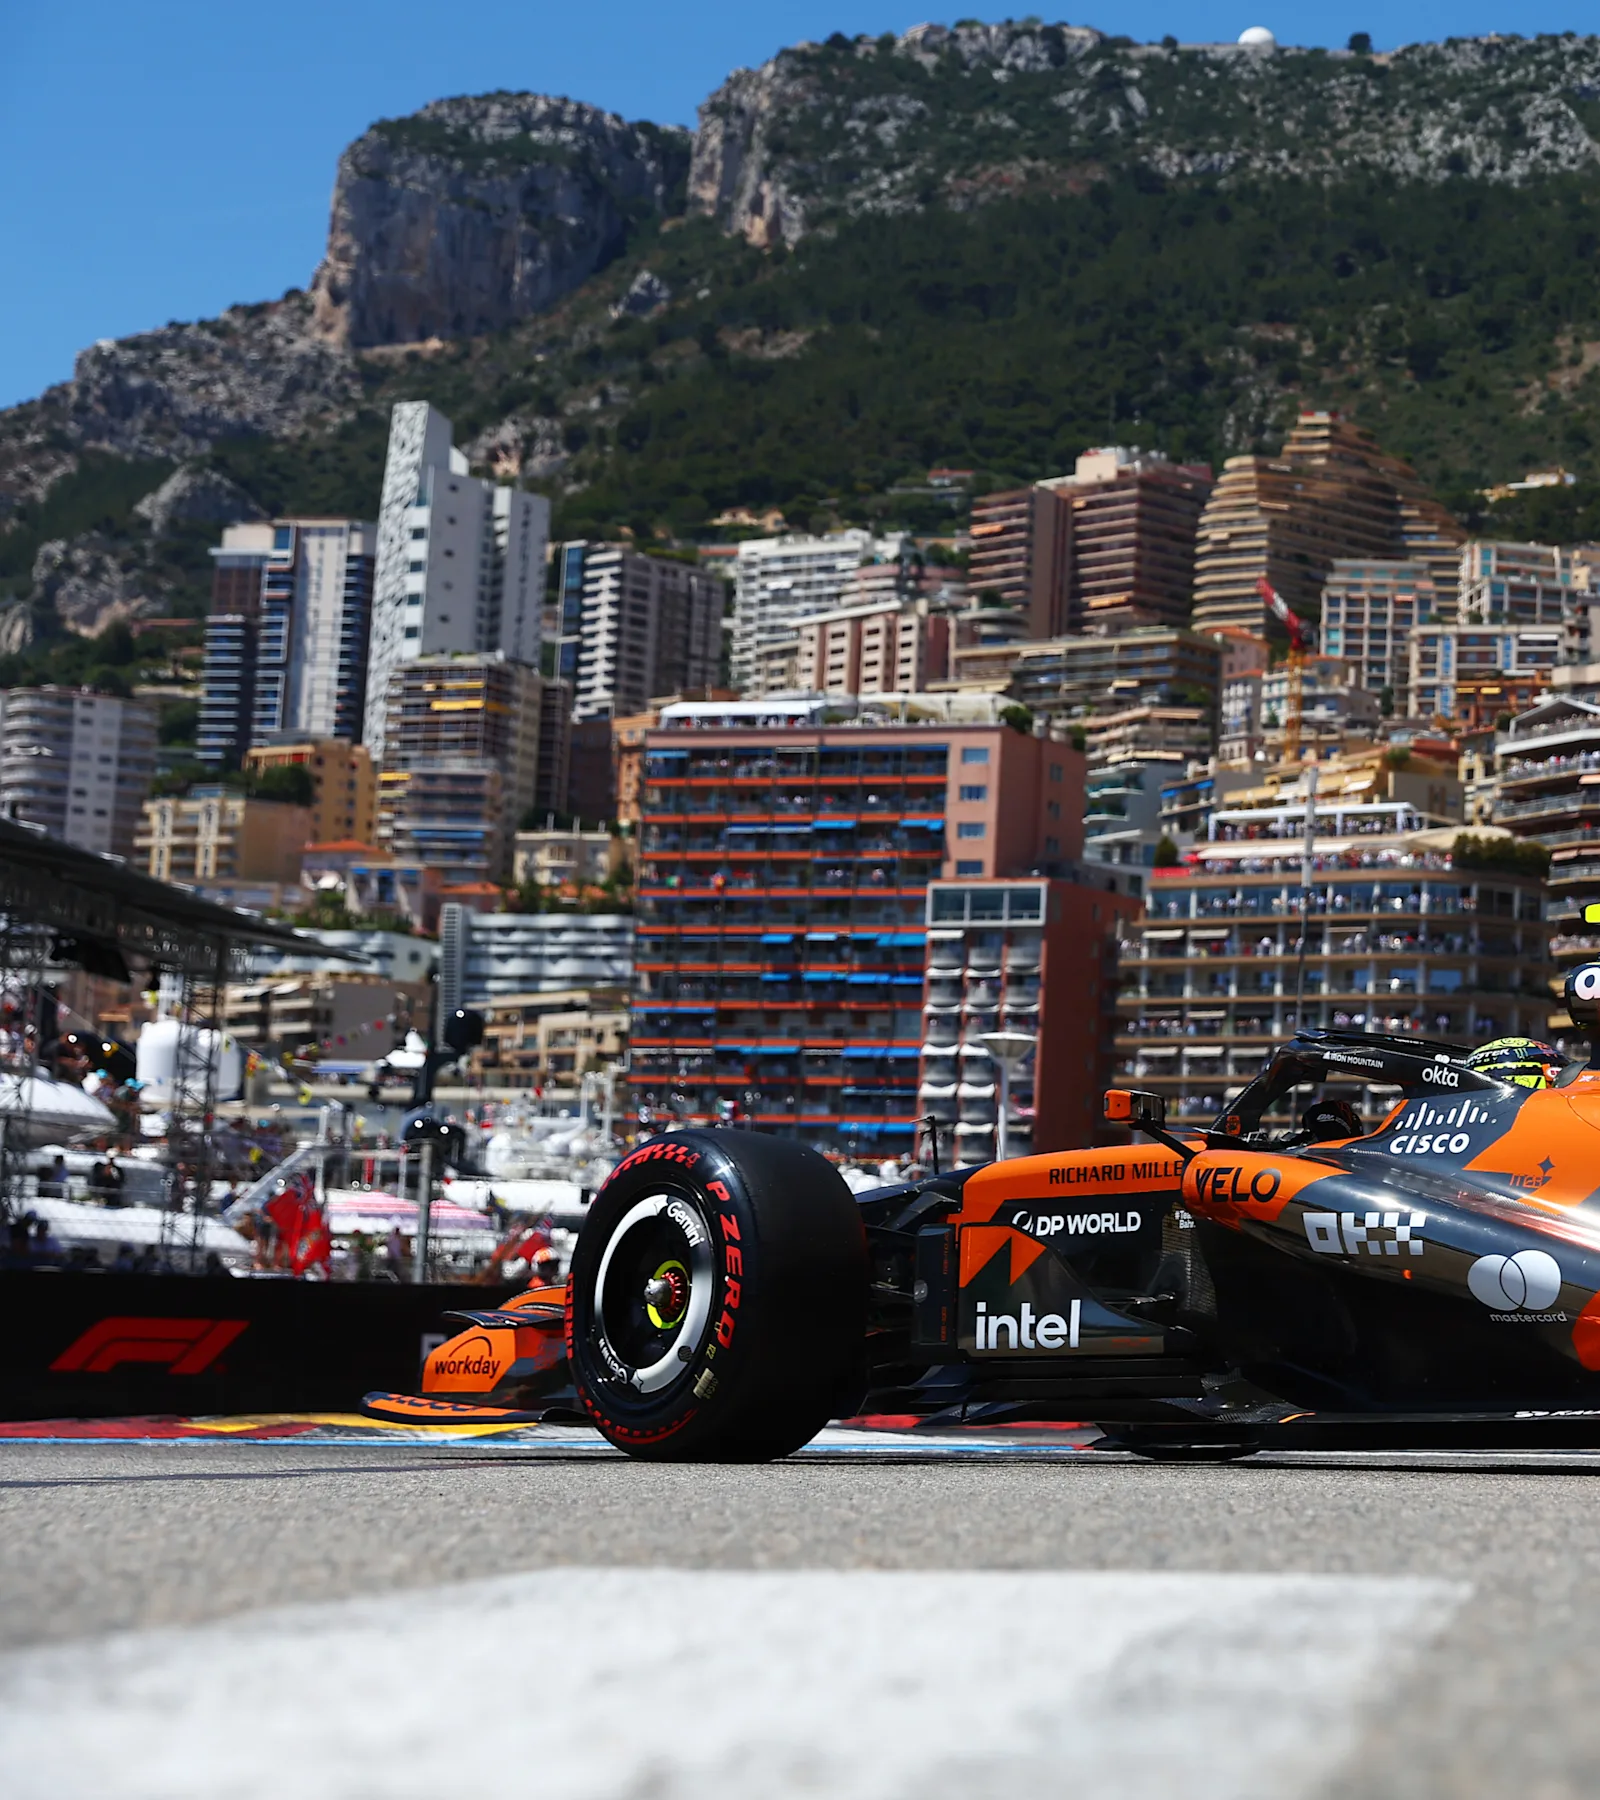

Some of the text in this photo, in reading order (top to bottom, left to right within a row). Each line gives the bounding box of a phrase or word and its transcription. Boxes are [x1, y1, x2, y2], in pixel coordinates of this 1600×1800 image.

[1330, 1053, 1384, 1069] IRON MOUNTAIN
[1421, 1065, 1459, 1088] okta
[1049, 1159, 1183, 1184] RICHARD MILLE
[1195, 1167, 1282, 1204] VELO
[667, 1201, 705, 1247] Gemini
[1036, 1211, 1141, 1236] DP WORLD
[1303, 1212, 1427, 1255] OKX
[706, 1180, 744, 1349] P ZERO
[976, 1299, 1080, 1349] intel
[1490, 1311, 1567, 1323] mastercard
[49, 1316, 250, 1375] F1
[435, 1355, 501, 1379] workday
